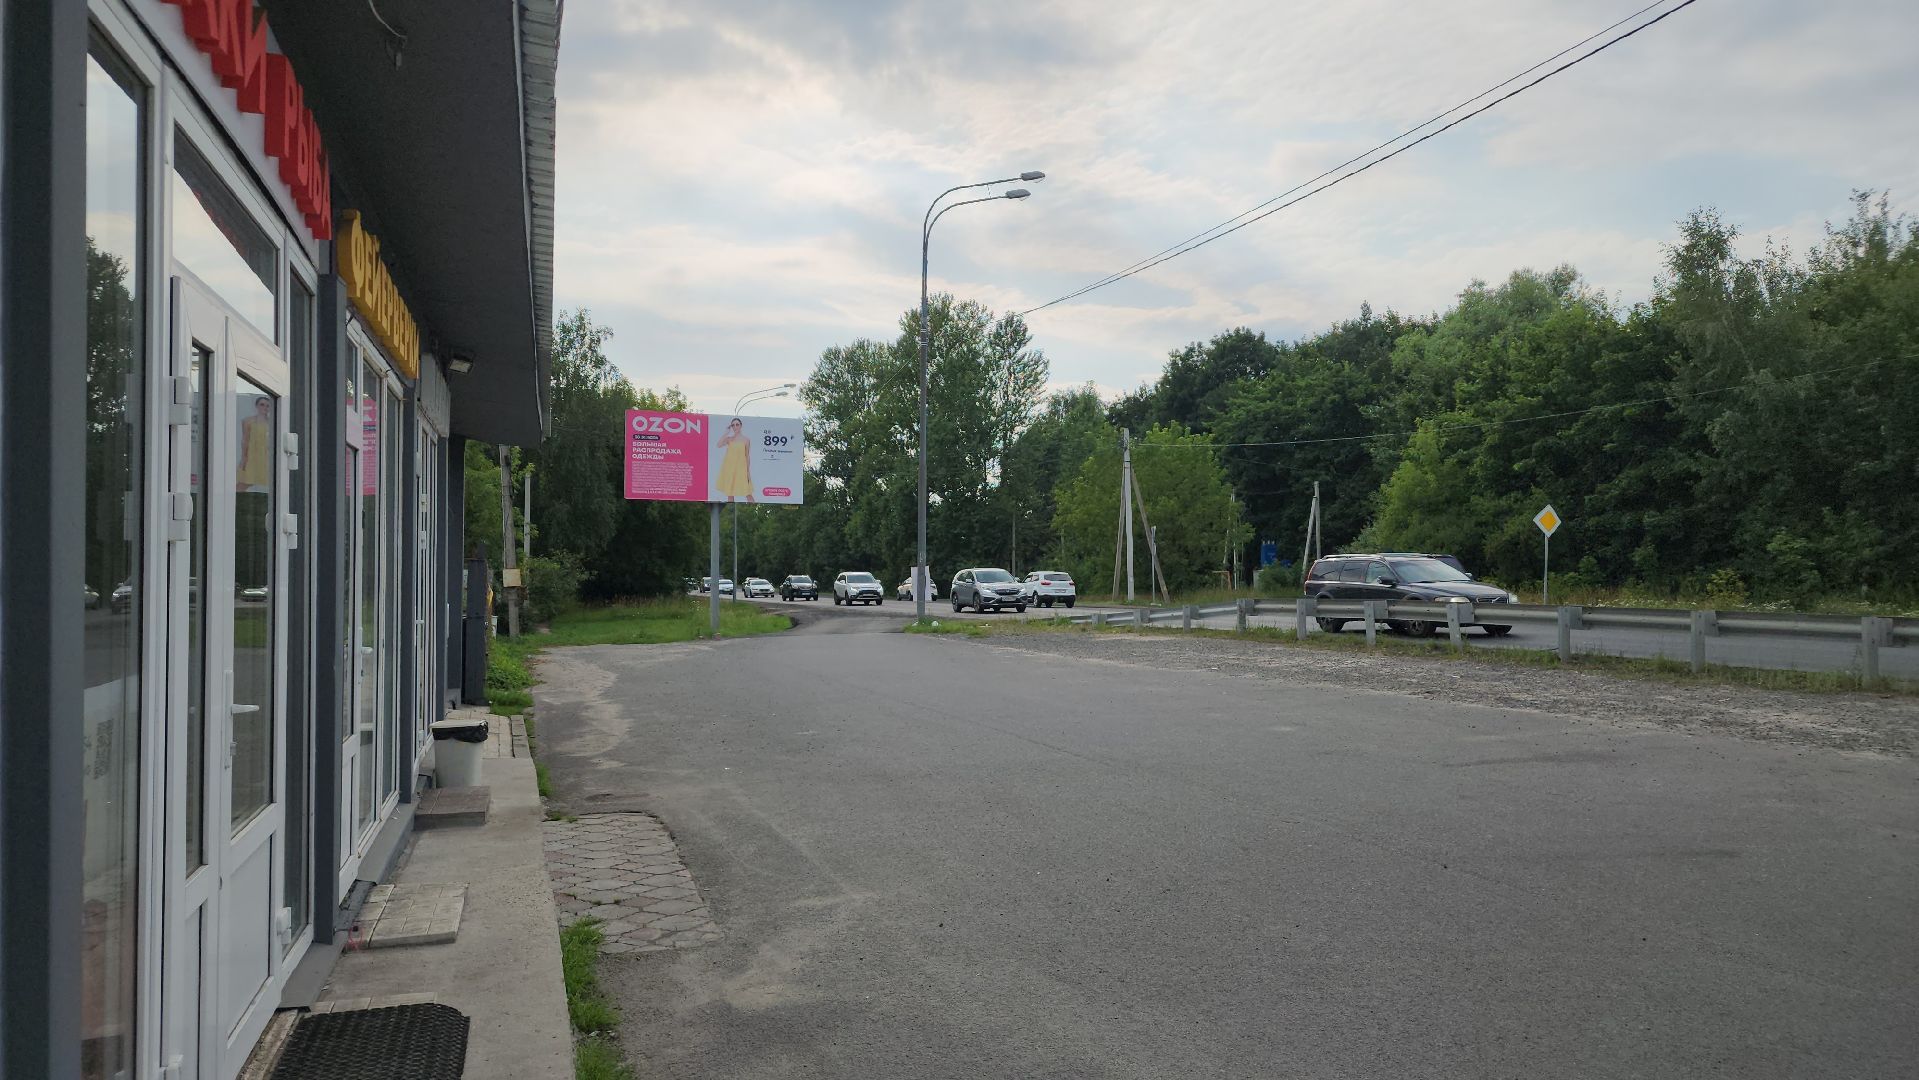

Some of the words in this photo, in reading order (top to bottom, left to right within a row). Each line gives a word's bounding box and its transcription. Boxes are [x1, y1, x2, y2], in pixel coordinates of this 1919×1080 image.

[265, 52, 332, 240] РЫБА
[338, 209, 421, 380] ФЕЙЕРВЕРКИ
[632, 415, 701, 434] OZON
[763, 435, 788, 446] 899
[632, 447, 682, 455] РАСПРОДАЖА
